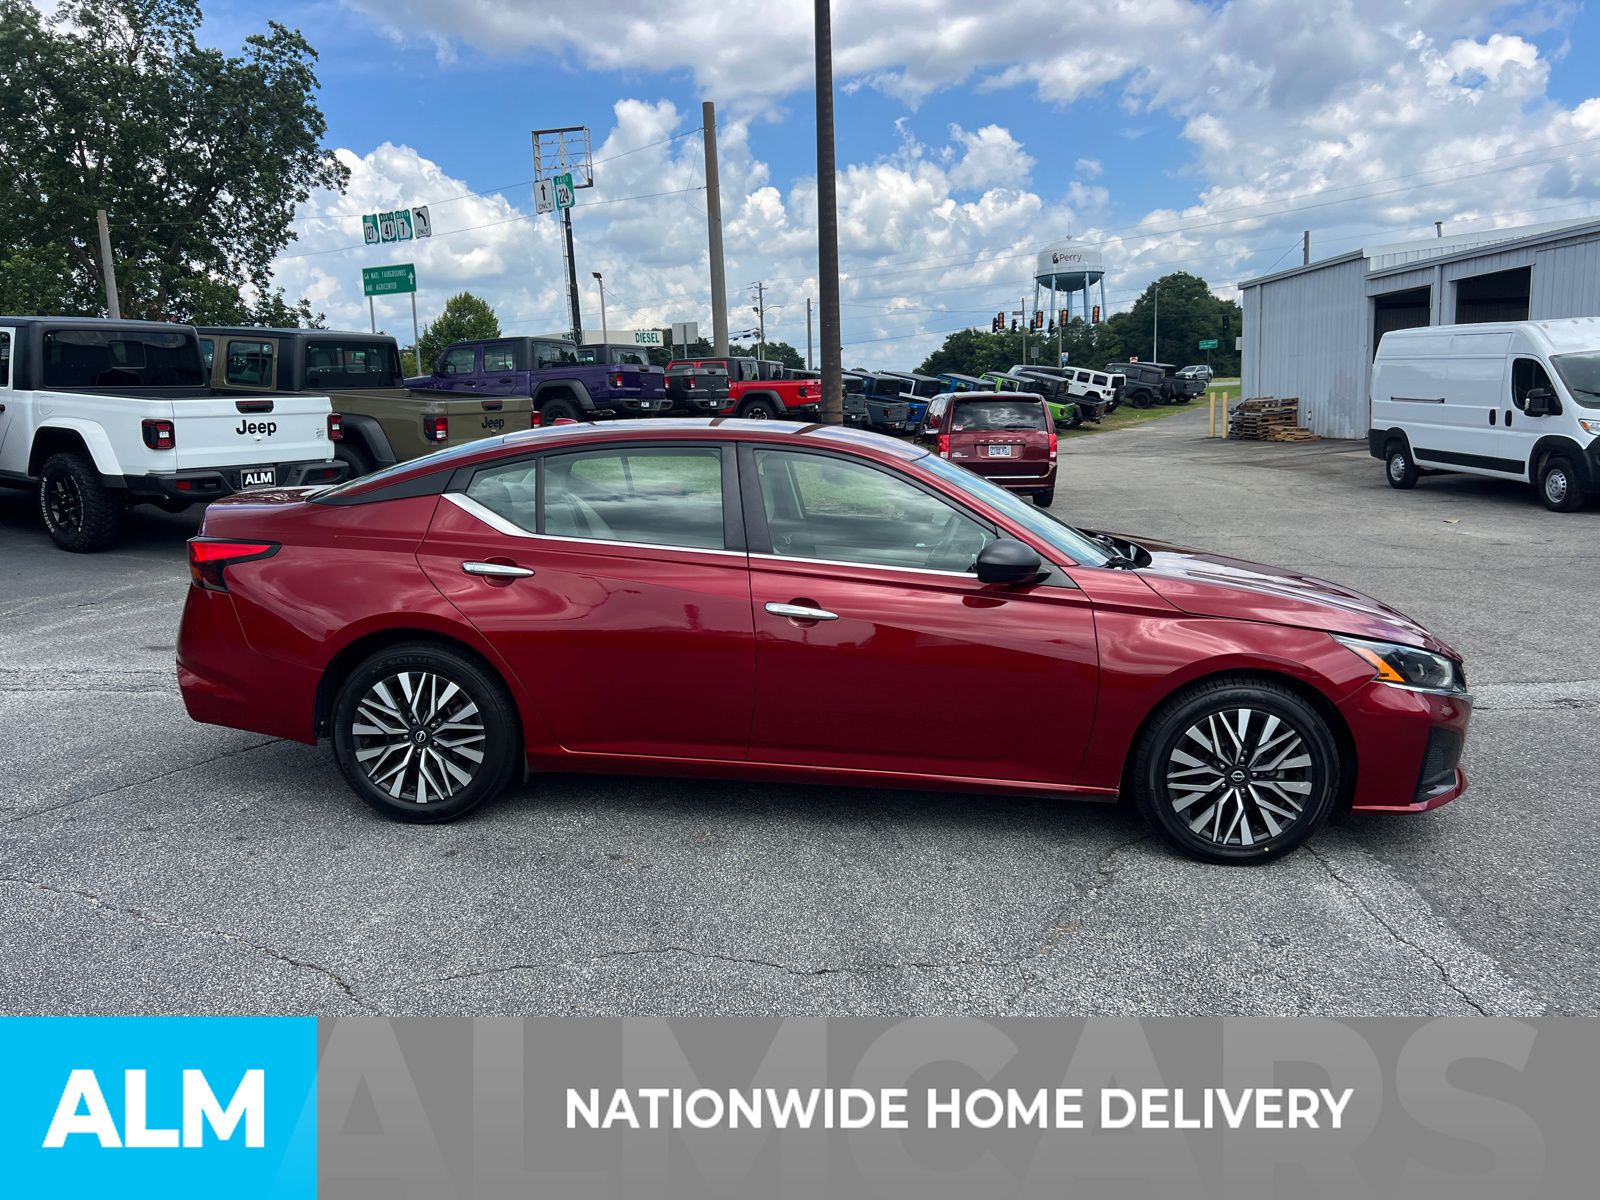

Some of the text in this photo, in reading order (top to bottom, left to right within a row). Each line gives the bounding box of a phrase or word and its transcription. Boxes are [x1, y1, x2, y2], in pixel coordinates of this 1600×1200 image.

[558, 187, 570, 204] 224
[538, 202, 552, 210] ONLY
[365, 225, 374, 240] 127
[384, 223, 393, 238] 41
[400, 221, 406, 236] 7
[417, 227, 429, 235] ONLY
[1059, 253, 1082, 263] Perry
[635, 332, 660, 344] DIESEL
[236, 419, 277, 436] Jeep
[481, 416, 505, 431] Jeep
[245, 472, 273, 485] ALM
